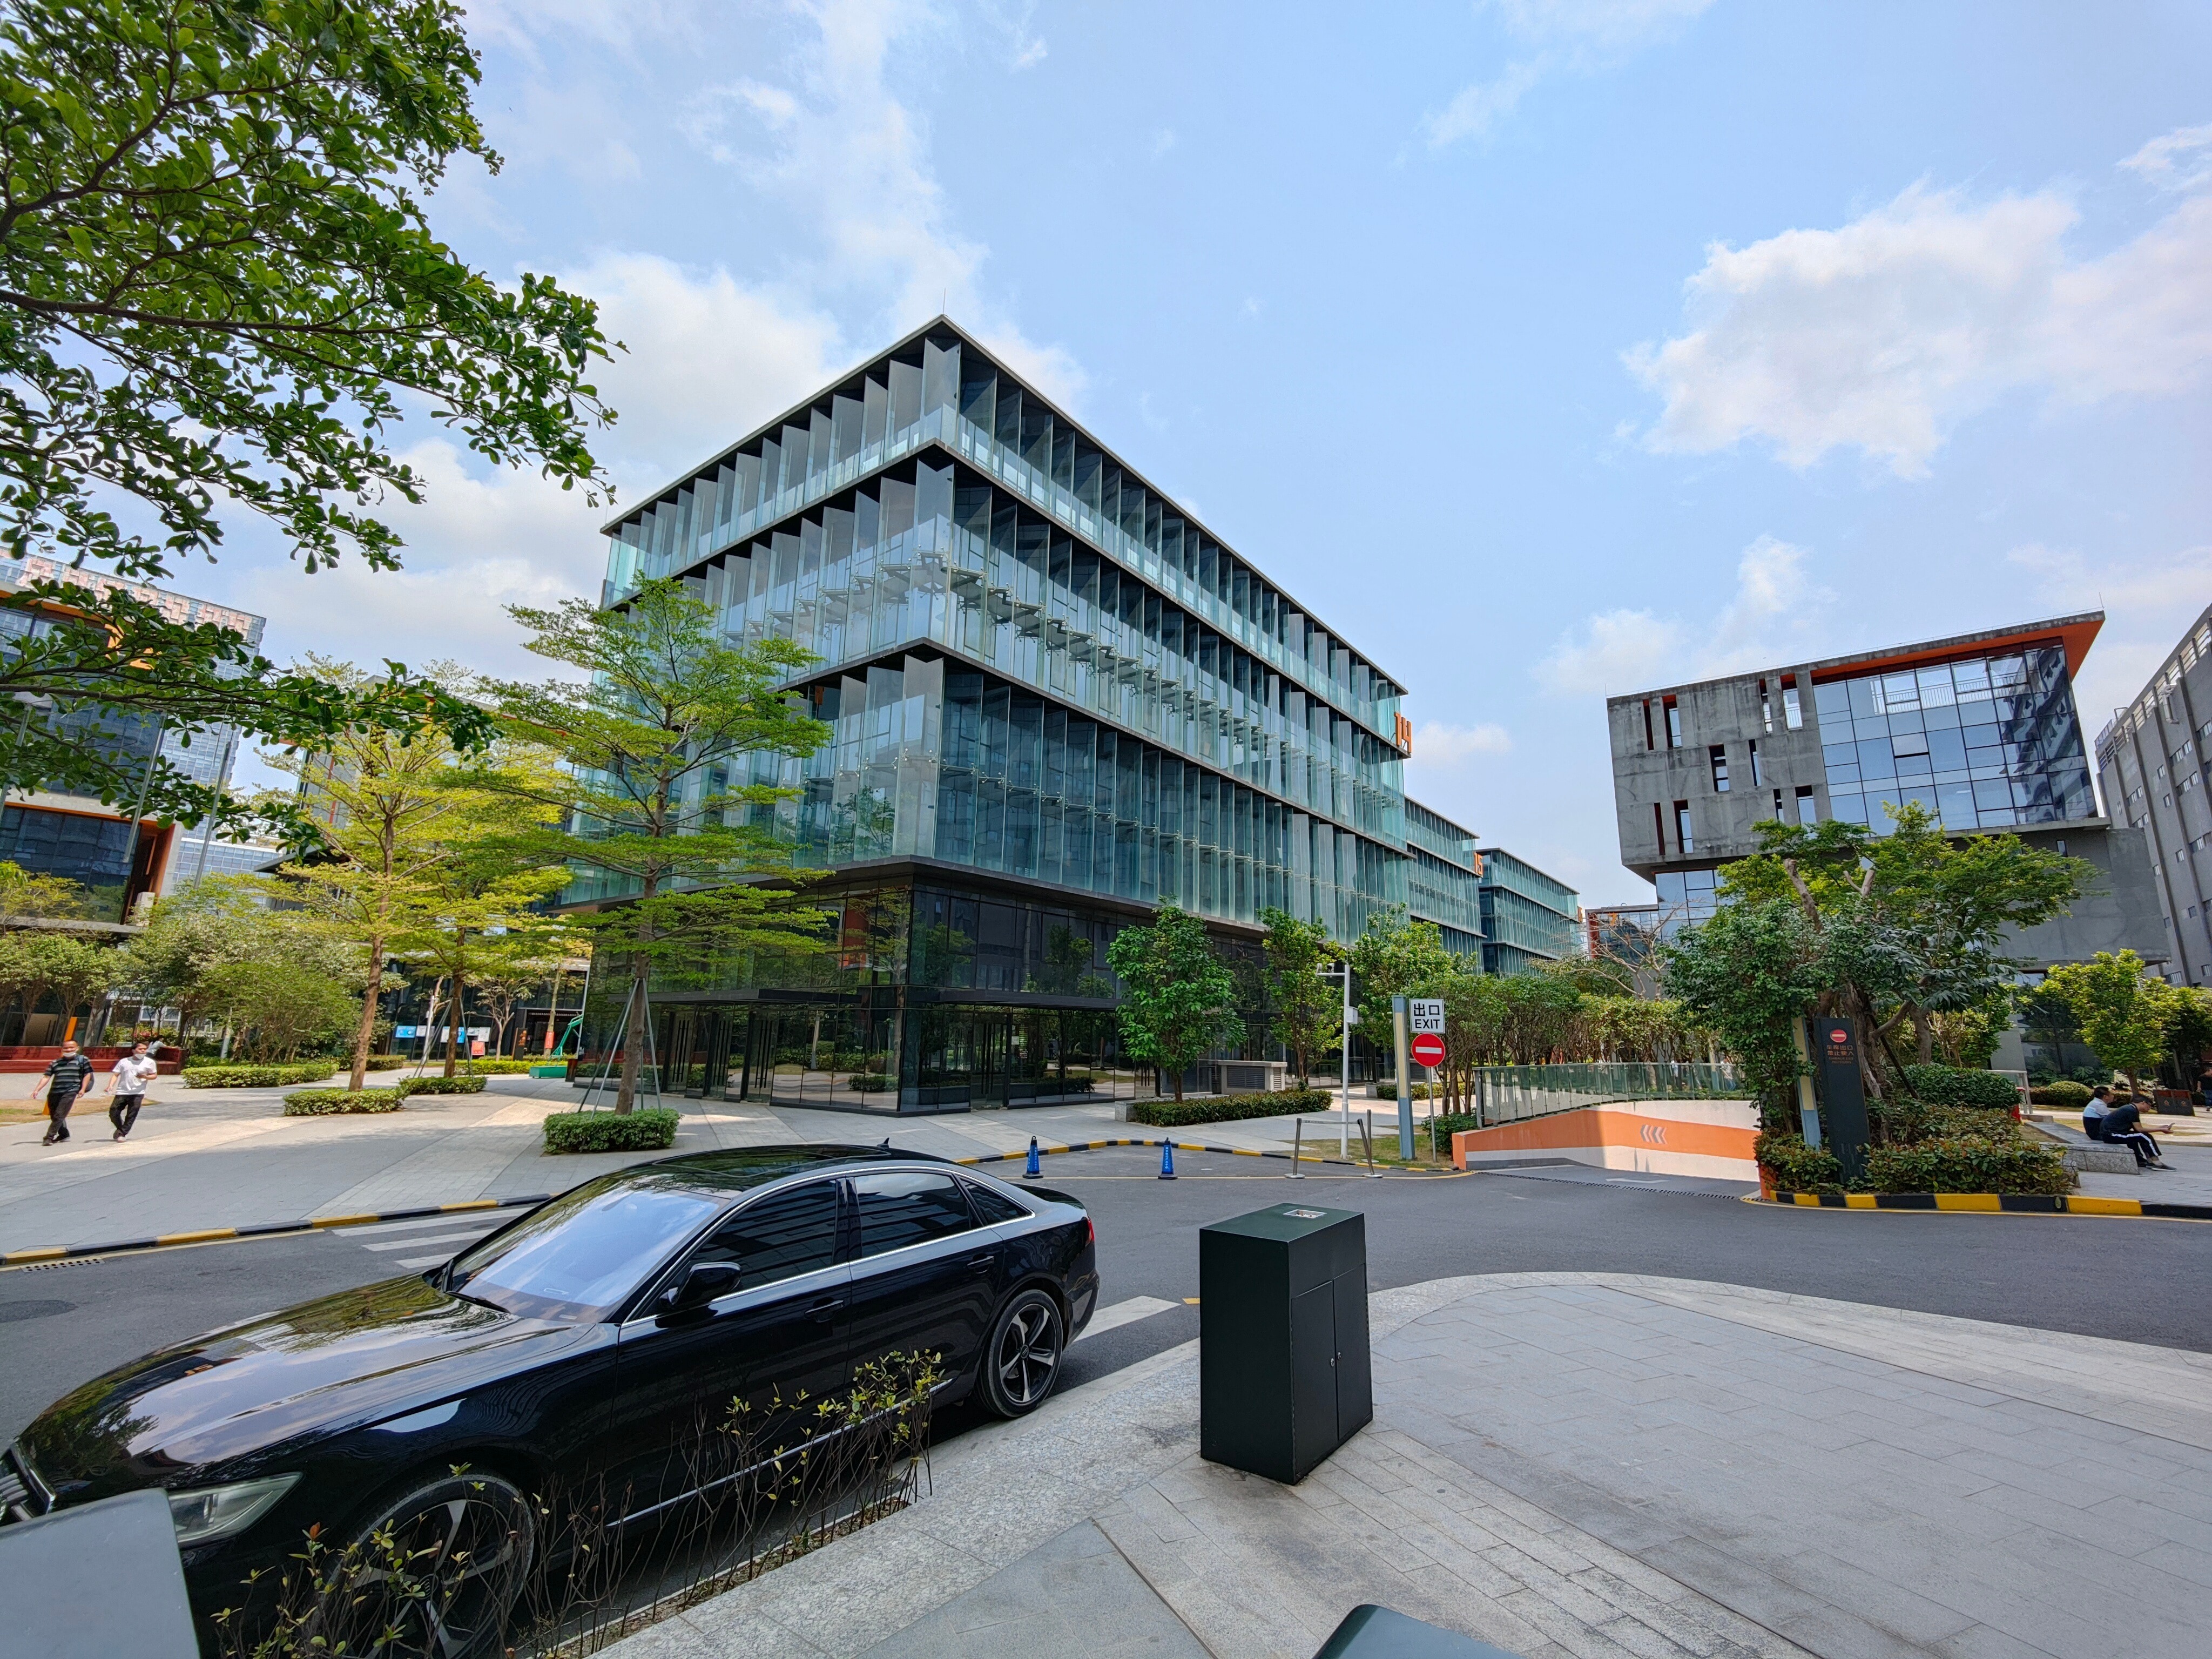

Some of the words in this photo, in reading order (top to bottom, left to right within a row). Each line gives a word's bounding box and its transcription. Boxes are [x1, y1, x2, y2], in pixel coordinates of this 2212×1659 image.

[1394, 711, 1412, 753] 14
[1474, 852, 1483, 875] 15
[1414, 1003, 1440, 1016] 出口
[1415, 1019, 1440, 1029] EXIT
